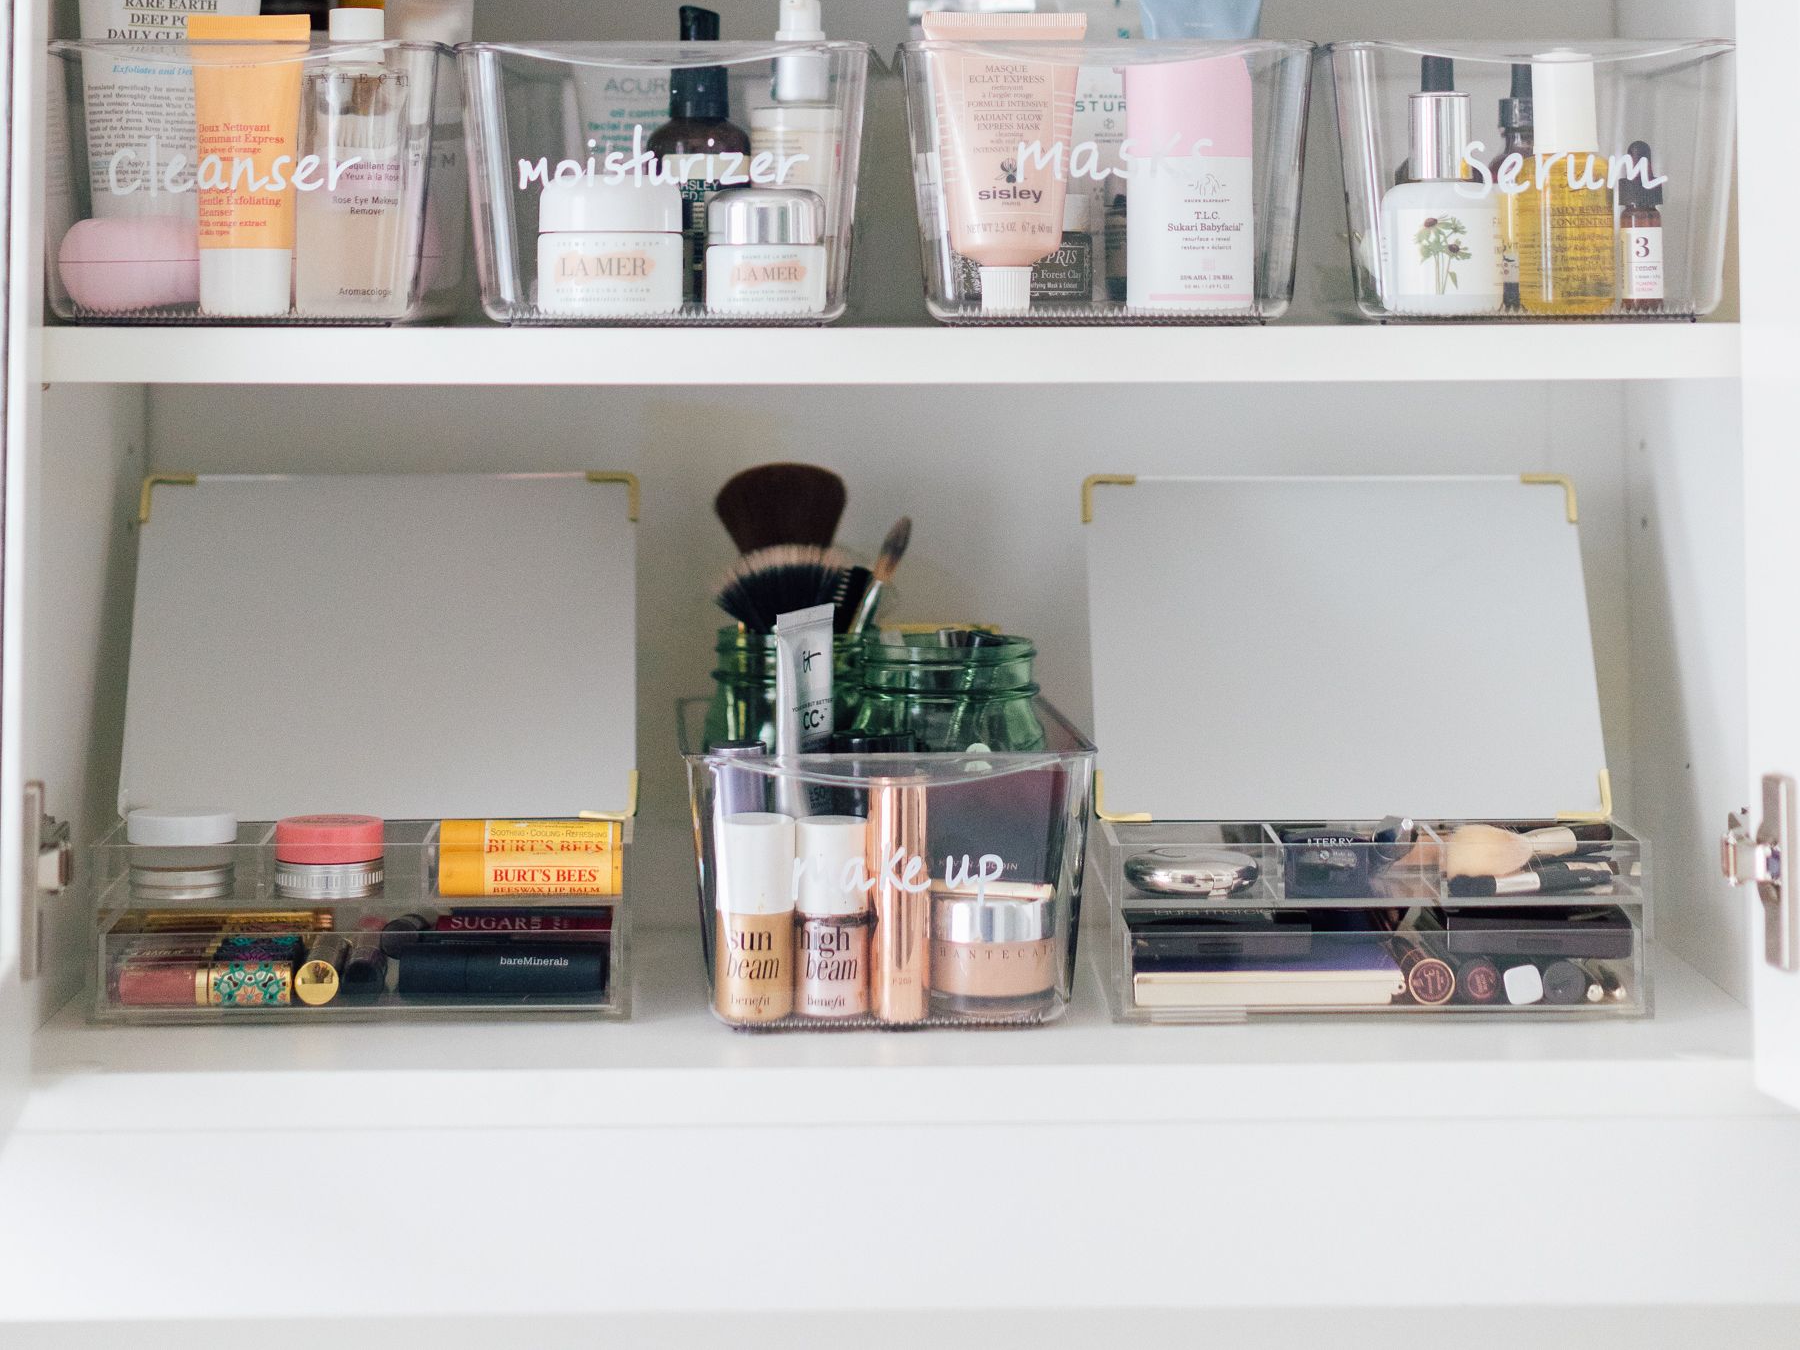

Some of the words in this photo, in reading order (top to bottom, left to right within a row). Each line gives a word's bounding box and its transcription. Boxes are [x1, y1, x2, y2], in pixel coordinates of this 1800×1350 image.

[130, 13, 168, 26] DEEP
[107, 28, 152, 41] DAILY
[112, 64, 156, 75] Exfoliates
[158, 66, 176, 75] and
[985, 64, 1029, 75] MASQUE
[604, 77, 668, 93] ACUR
[969, 74, 1001, 84] ECLAT
[1003, 74, 1046, 84] EXPRESS
[967, 100, 1005, 108] FORMULE
[1007, 100, 1049, 108] INTENSIVE
[1075, 100, 1127, 112] STUR
[973, 113, 1014, 122] RADIANT
[1016, 113, 1044, 122] GLOW
[223, 123, 271, 136] Nettoyant
[977, 122, 1014, 131] EXPRESS
[1016, 122, 1041, 131] MASK
[244, 134, 285, 146] Express
[517, 123, 810, 190] moisturizer
[108, 135, 363, 200] Cleanser
[1454, 140, 1668, 200] Serum
[345, 172, 365, 181] Yeux
[226, 195, 282, 207] Exfoliating
[978, 185, 1043, 204] sisley
[354, 196, 369, 207] Eye
[371, 196, 399, 207] Makeup
[350, 207, 385, 216] Remover
[1194, 211, 1221, 220] T.L.C.
[239, 219, 267, 227] extract
[1167, 222, 1199, 232] Sukari
[1200, 222, 1241, 233] Babyfacial
[1635, 236, 1650, 258] 3
[560, 256, 590, 277] LA
[594, 256, 648, 277] MER
[736, 266, 758, 281] LA
[762, 266, 800, 281] MER
[1040, 269, 1067, 279] Forest
[487, 839, 553, 854] BURT'S
[559, 840, 607, 854] BEES
[1312, 837, 1354, 847] TERRY
[492, 868, 552, 883] BURT'S
[556, 868, 598, 883] BEES
[945, 853, 1004, 907] up
[450, 916, 527, 931] SUGAR
[726, 927, 772, 952] sun
[800, 925, 850, 959] high
[499, 956, 570, 967] bareMinerals
[726, 953, 780, 981] beam
[805, 953, 858, 981] beam
[730, 993, 770, 1010] benefit
[807, 993, 846, 1010] benefit
